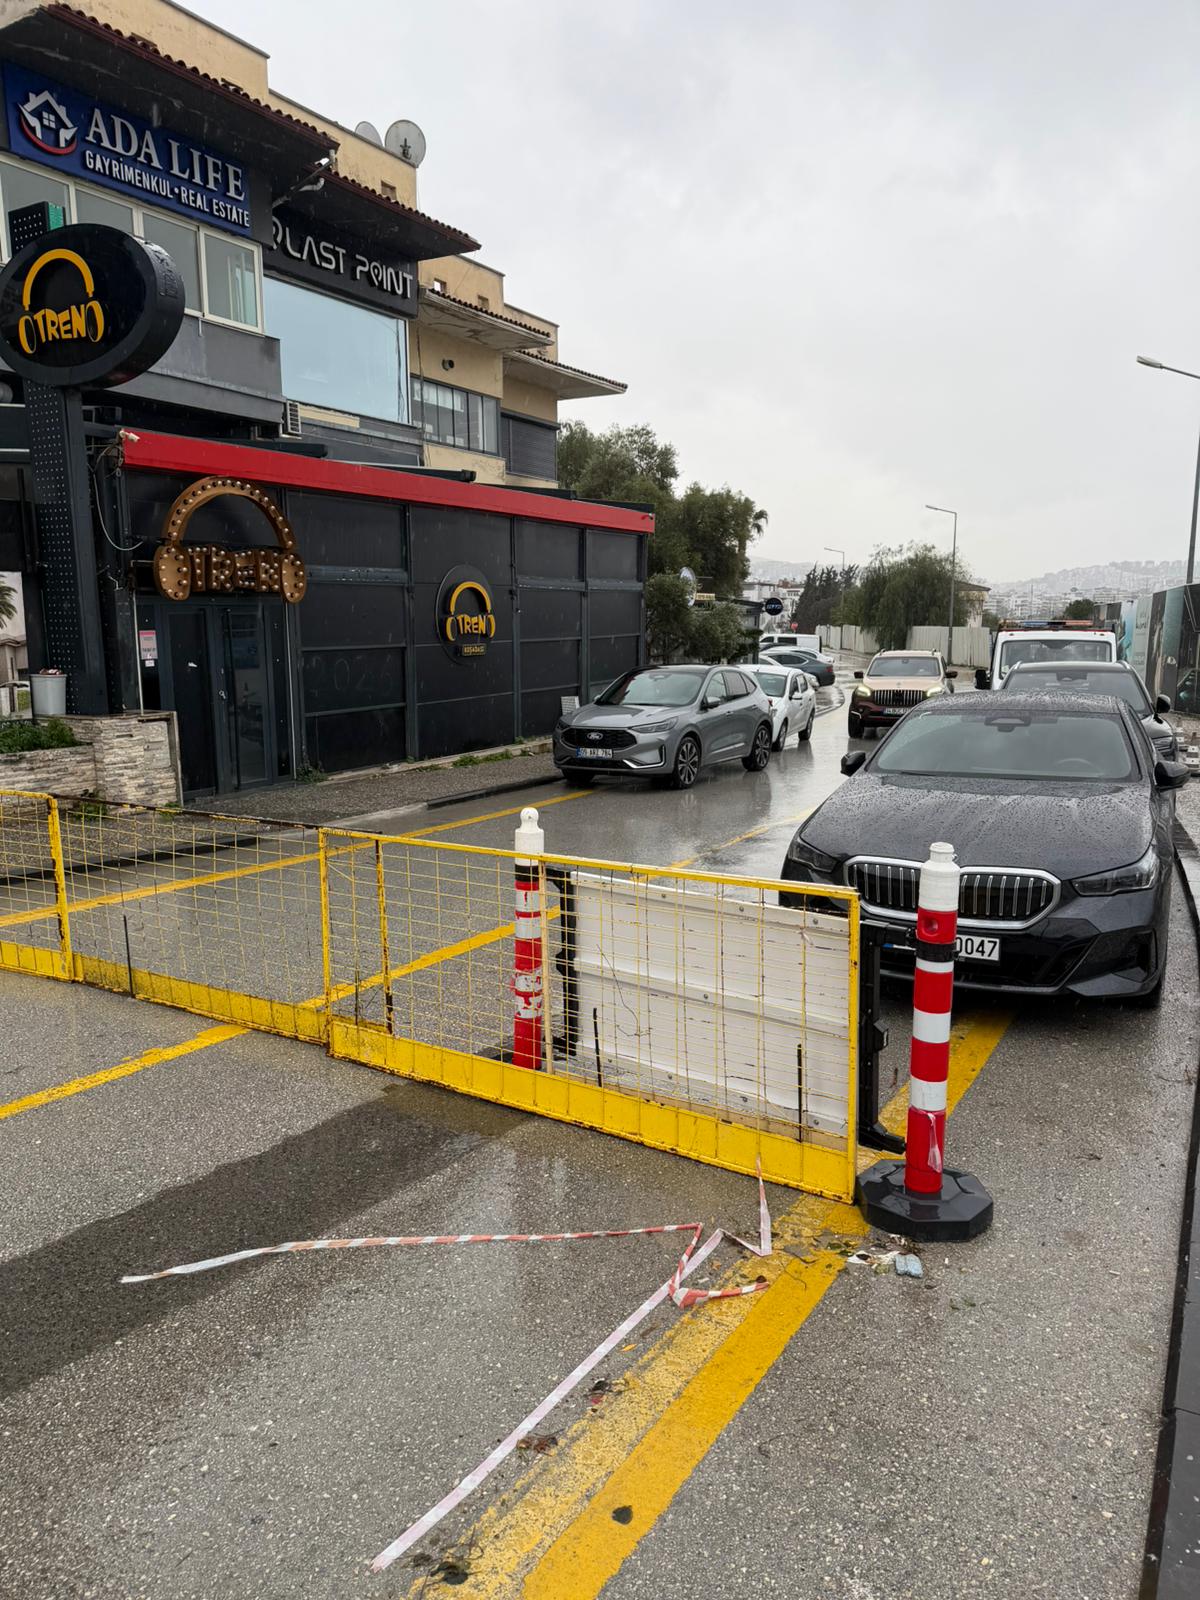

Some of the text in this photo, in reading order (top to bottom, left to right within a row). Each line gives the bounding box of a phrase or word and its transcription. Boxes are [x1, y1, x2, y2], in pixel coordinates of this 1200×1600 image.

[85, 108, 246, 201] ADA LIFE
[85, 150, 250, 228] GAYRİMENKUL REAL ESTATE
[285, 226, 414, 299] LAST POINT
